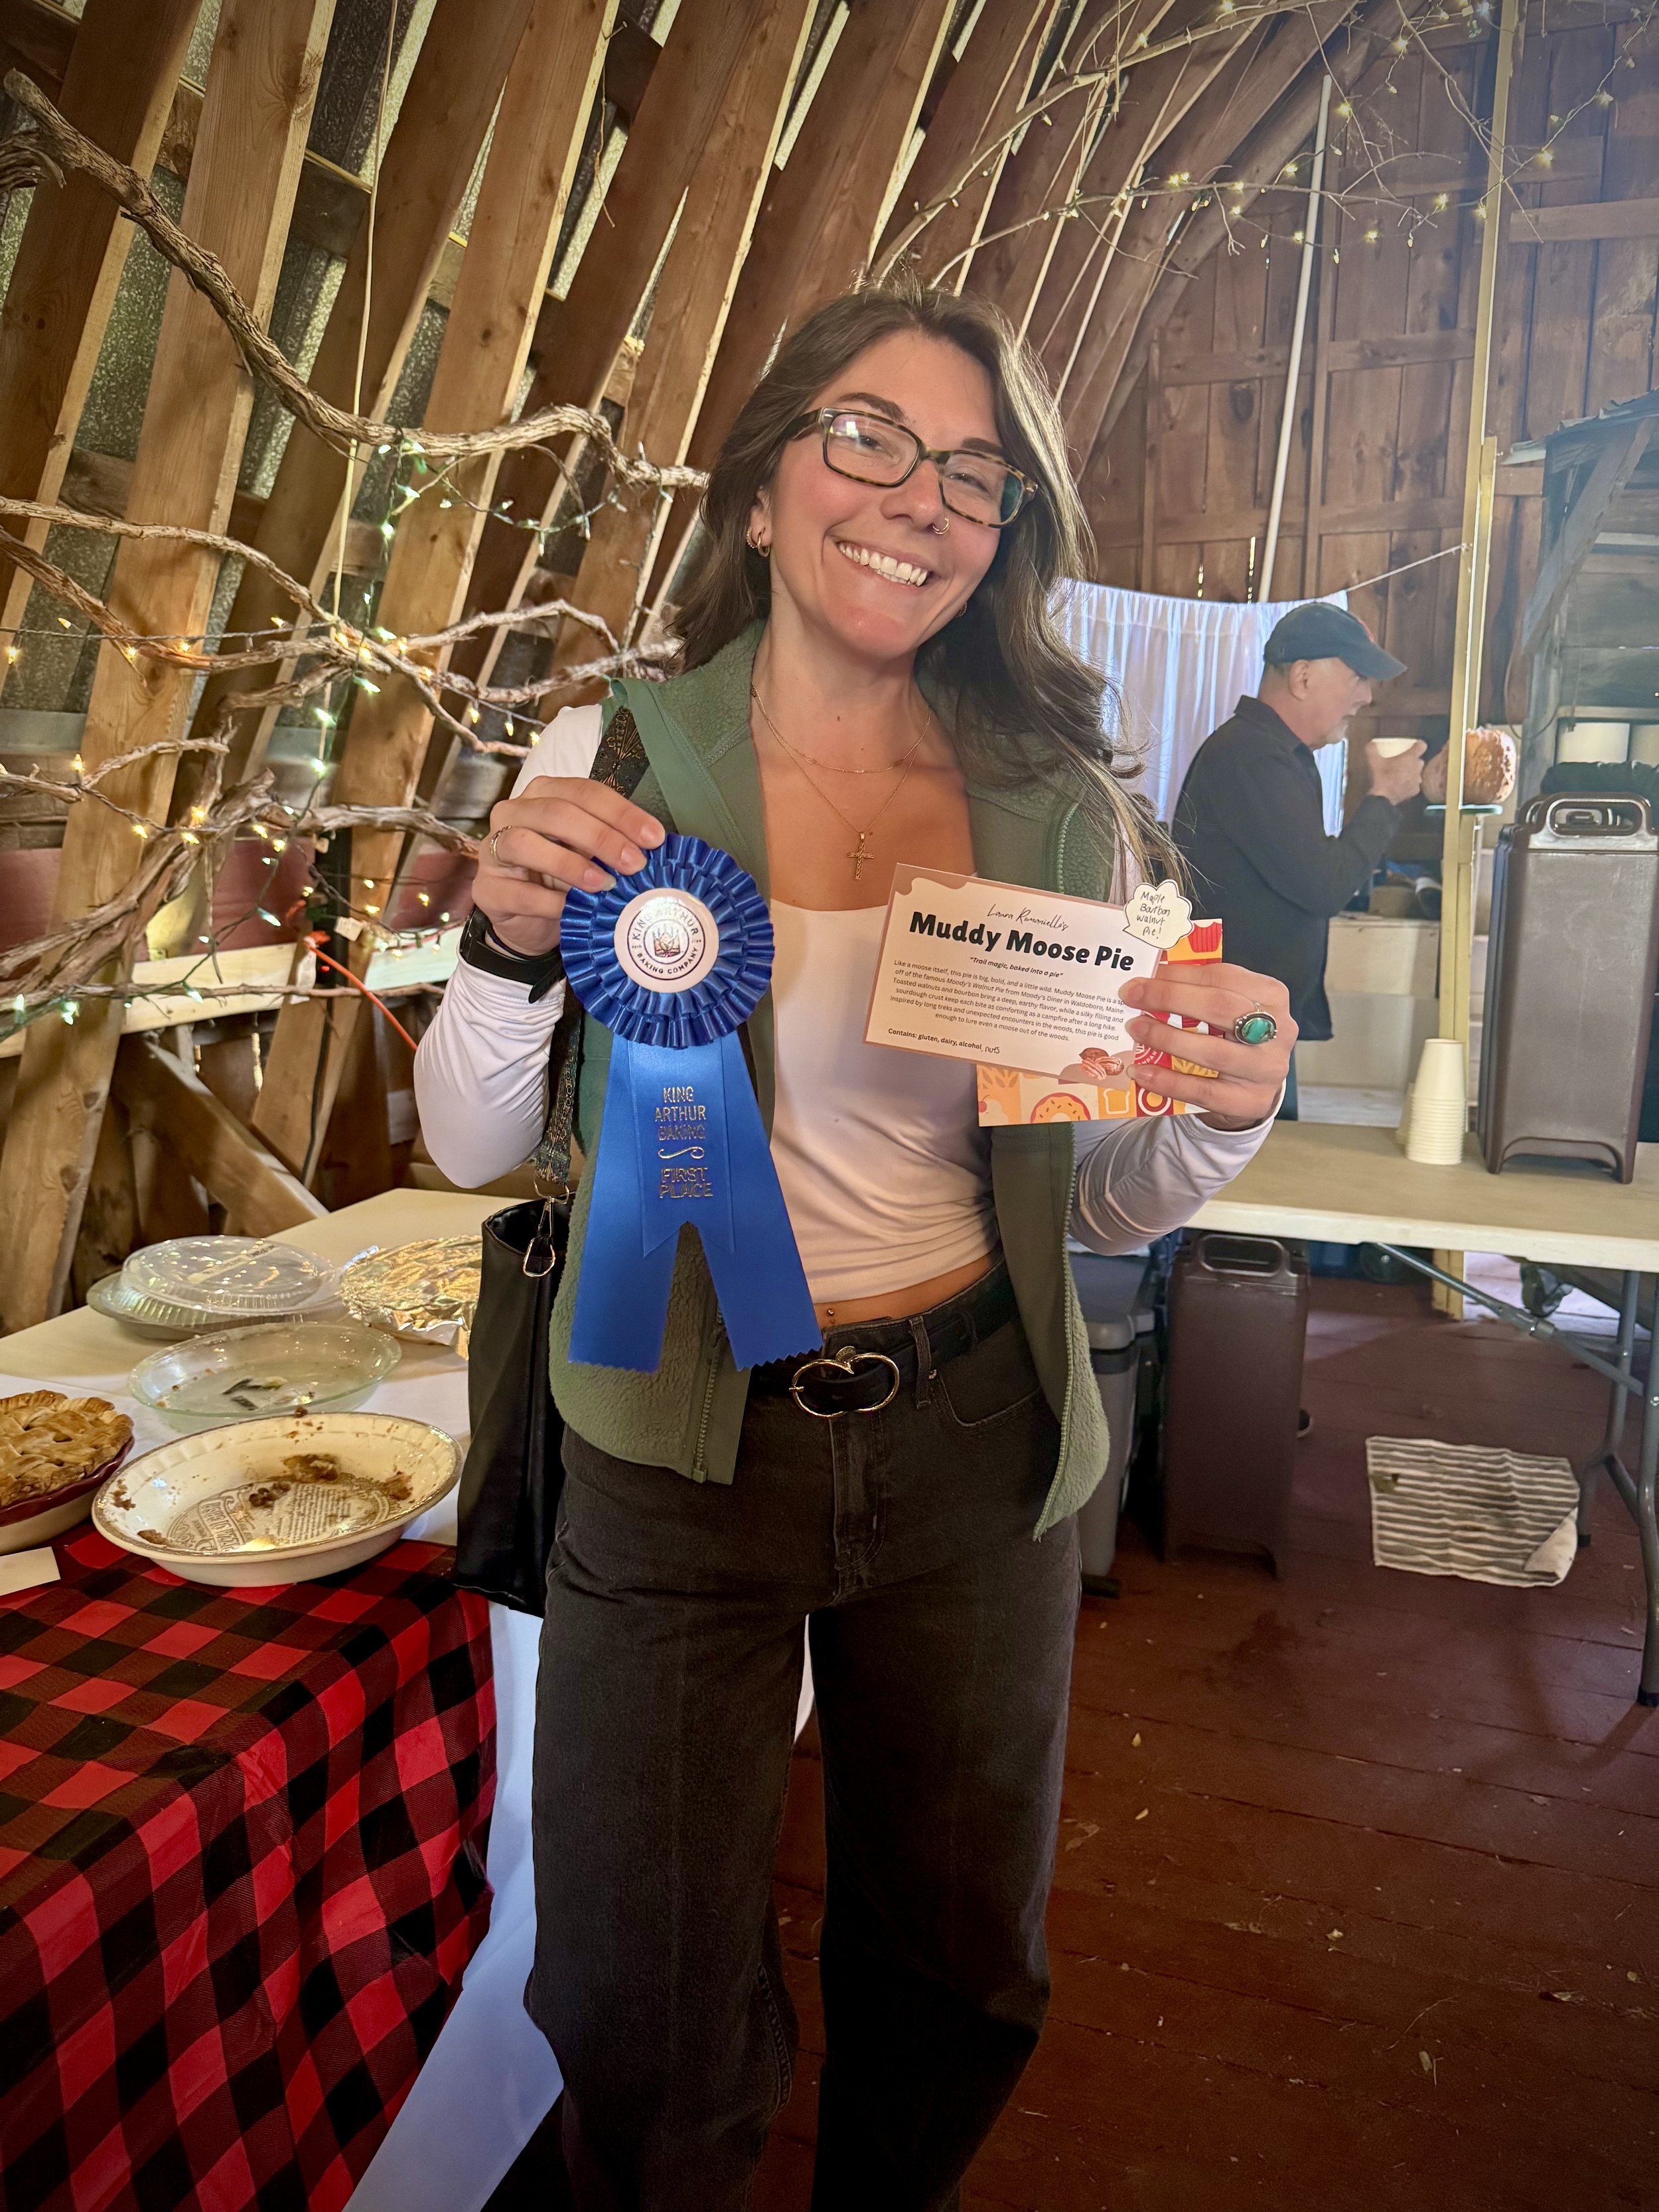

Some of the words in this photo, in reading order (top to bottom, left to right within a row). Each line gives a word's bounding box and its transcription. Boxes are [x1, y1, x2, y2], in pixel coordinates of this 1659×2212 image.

[1140, 891, 1165, 905] Maple
[987, 903, 1013, 920] Laura
[1015, 907, 1069, 931] Romaniello's
[909, 911, 1002, 952] Muddy
[1006, 929, 1090, 964] Moose
[1094, 945, 1134, 971] Pie
[637, 952, 664, 974] BAKING
[667, 947, 698, 974] COMPANY
[987, 961, 1009, 970] magic,
[1009, 964, 1031, 972] baked
[932, 966, 949, 976] itself,
[979, 974, 989, 983] big,
[990, 976, 1006, 986] bold,
[1054, 988, 1075, 997] Muddy
[1075, 992, 1096, 1000] Moose
[893, 977, 917, 987] Toasted
[917, 983, 940, 992] walnuts
[954, 988, 979, 997] bourbon
[979, 992, 996, 1002] bring
[1001, 997, 1017, 1005] deep,
[1019, 1000, 1039, 1009] earthy
[1039, 1003, 1058, 1013] flavor,
[1080, 1011, 1094, 1019] silky
[1094, 1013, 1112, 1023] filling
[923, 974, 946, 983] famous
[946, 978, 972, 988] Moody's
[972, 982, 995, 992] Walnut
[1021, 991, 1046, 1001] Moody's
[1070, 999, 1104, 1011] Waldoboro,
[1106, 1005, 1125, 1014] Maine.
[890, 995, 914, 1005] Inspired
[924, 1001, 937, 1010] long
[966, 1009, 1001, 1020] unexpected
[1001, 1015, 1035, 1026] encounters
[1053, 1025, 1074, 1034] woods,
[896, 988, 928, 998] sourdough
[944, 995, 959, 1004] keep
[995, 1005, 1029, 1017] comforting
[1041, 1013, 1068, 1023] campfire
[1089, 1021, 1102, 1030] long
[935, 1013, 957, 1022] enough
[888, 1028, 918, 1039] Contains:
[917, 1034, 940, 1043] gluten,
[940, 1037, 958, 1047] dairy,
[663, 1086, 694, 1103] KING
[654, 1105, 706, 1122] ARTHUR
[658, 1124, 706, 1141] BAKING
[661, 1167, 709, 1183] FIRST
[659, 1183, 713, 1199] PLACE
